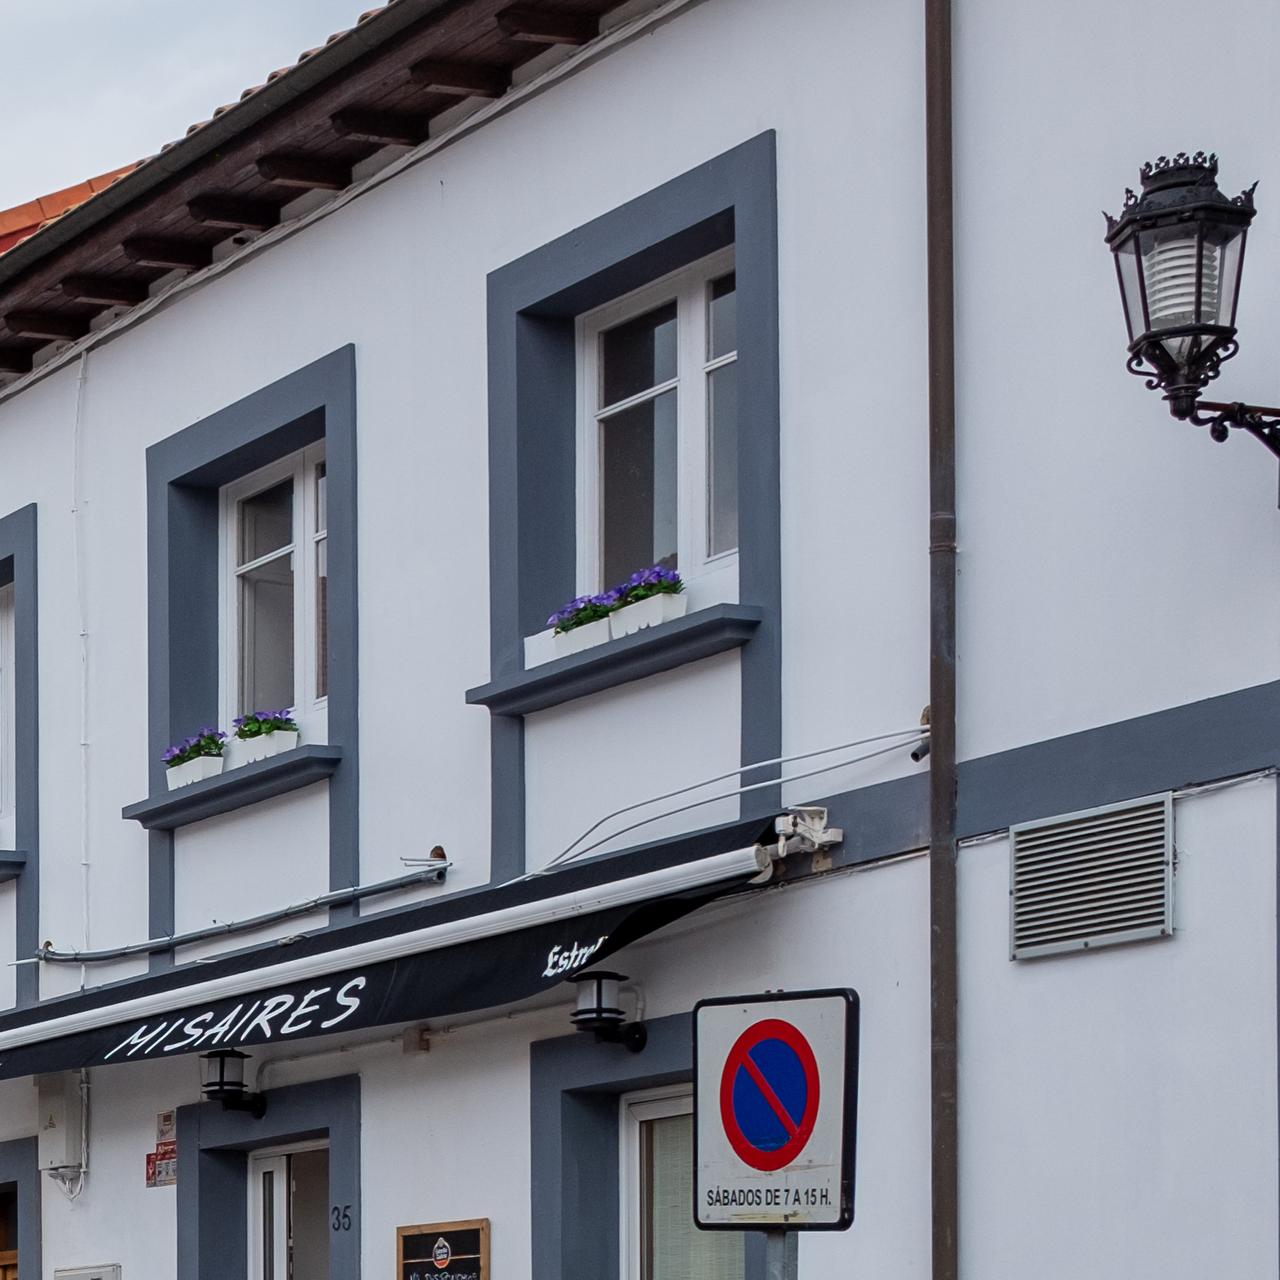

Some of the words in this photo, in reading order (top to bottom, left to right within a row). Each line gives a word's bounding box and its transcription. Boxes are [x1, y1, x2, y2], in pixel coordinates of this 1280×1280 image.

[104, 976, 366, 1060] MISAIRES
[706, 1185, 762, 1206] SÁBADOS
[765, 1189, 781, 1206] DE
[784, 1189, 791, 1206] 7
[792, 1189, 801, 1205] A
[804, 1189, 817, 1205] 15
[820, 1189, 832, 1205] H.
[331, 1205, 352, 1231] 35
